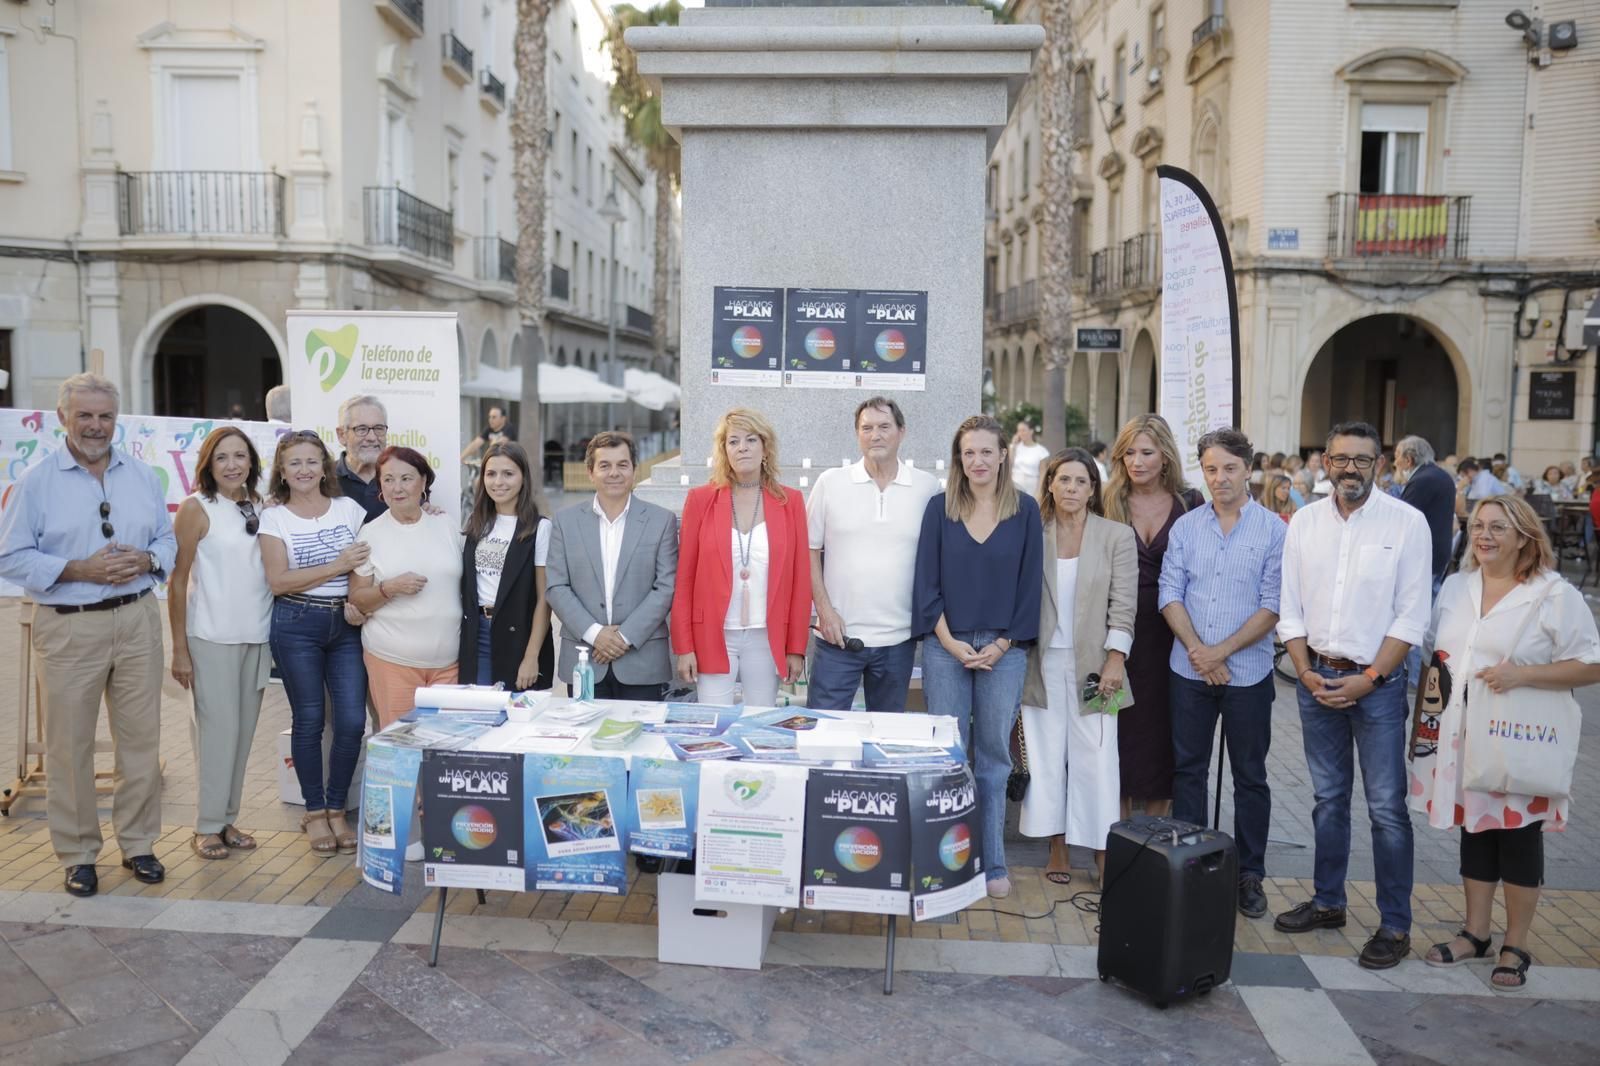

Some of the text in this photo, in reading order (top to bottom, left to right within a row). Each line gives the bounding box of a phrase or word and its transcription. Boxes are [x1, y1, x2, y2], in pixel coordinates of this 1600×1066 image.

[728, 300, 773, 309] HAGAMOS
[802, 301, 847, 311] HAGAMOS
[872, 303, 917, 312] HAGAMOS
[733, 306, 772, 318] PLAN
[806, 308, 846, 319] PLAN
[876, 310, 916, 321] PLAN
[361, 345, 433, 363] Teléfono de
[360, 363, 440, 385] la esperanza
[386, 429, 427, 448] encillo
[1488, 719, 1559, 745] HUELVA
[445, 769, 509, 781] HAGAMOS
[438, 776, 508, 795] UN PLAN
[831, 789, 898, 803] HAGAMOS
[926, 799, 938, 808] UN
[939, 788, 975, 814] PLAN
[824, 796, 896, 816] UN PLAN
